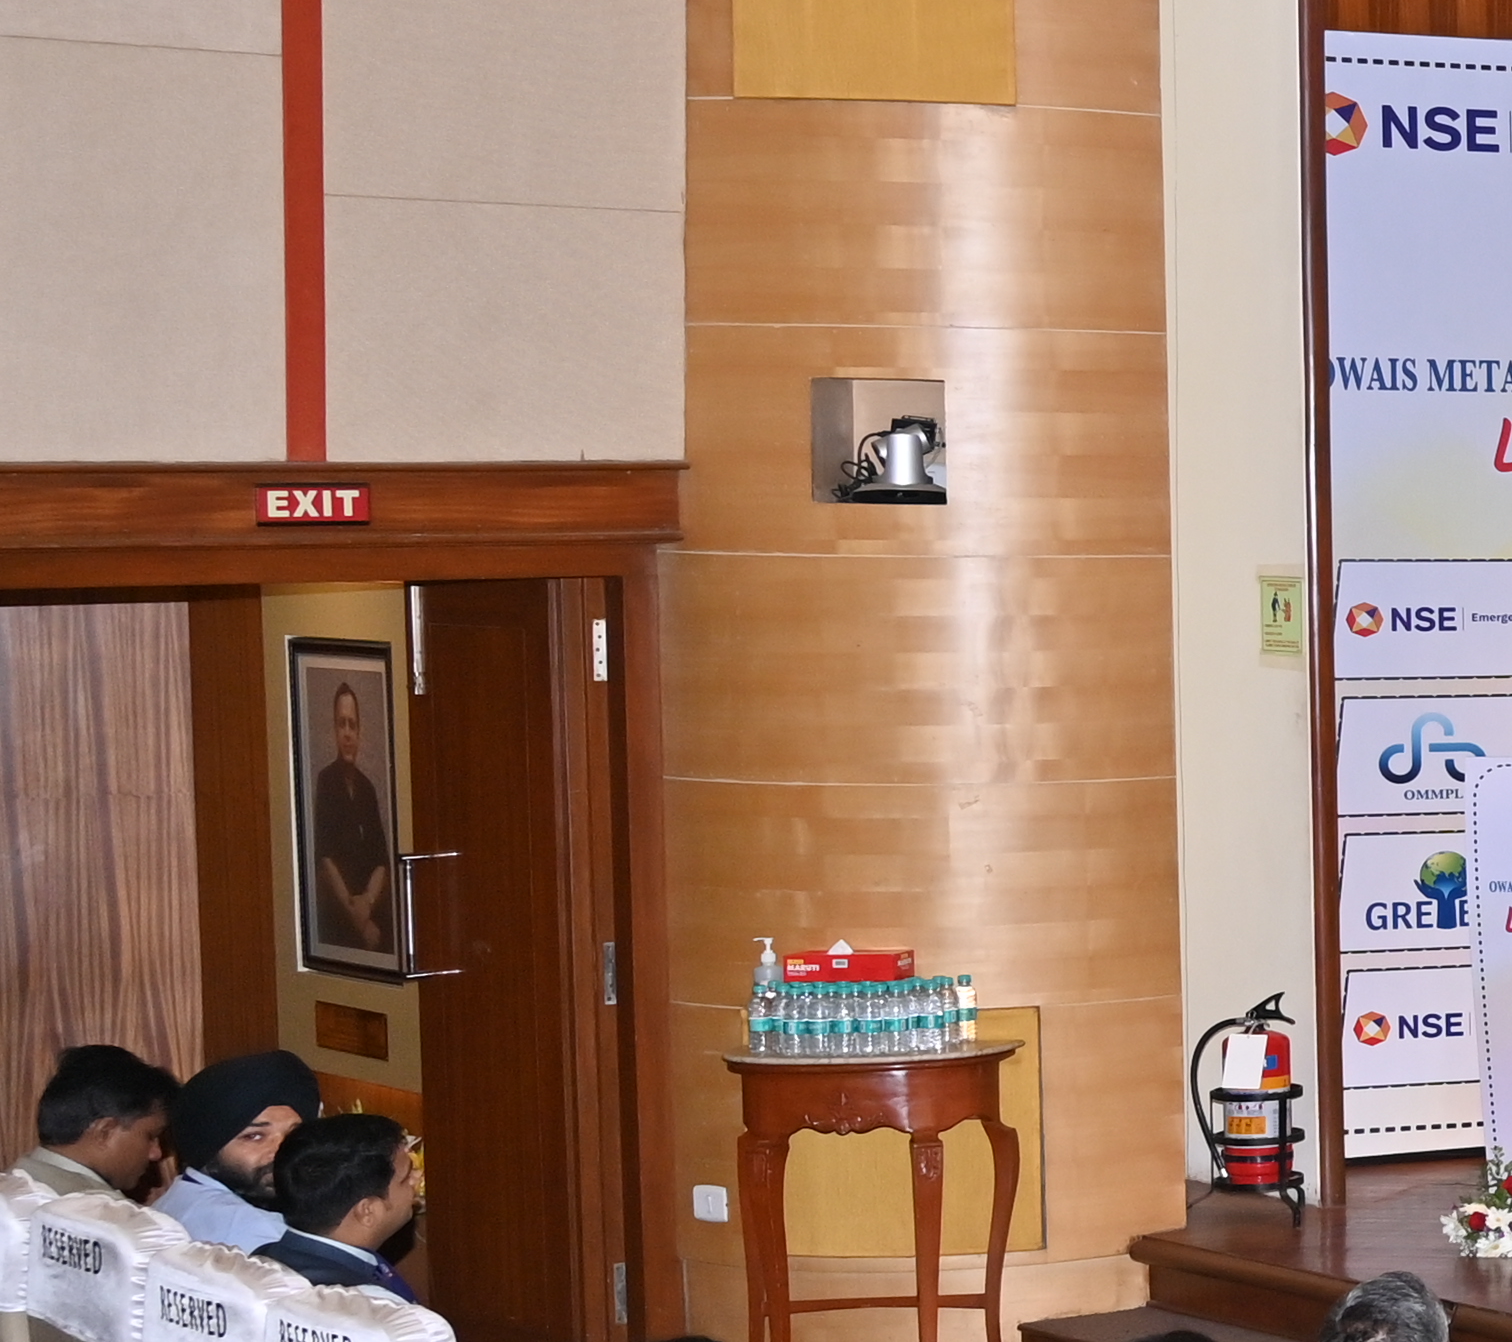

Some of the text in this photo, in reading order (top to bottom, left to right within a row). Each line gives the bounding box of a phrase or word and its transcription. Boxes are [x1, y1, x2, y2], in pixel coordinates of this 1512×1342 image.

[1381, 104, 1500, 153] NSE
[267, 490, 359, 517] EXIT
[1391, 606, 1458, 632] NSE
[41, 1225, 102, 1275] RESERVED
[159, 1285, 227, 1339] RESERVED
